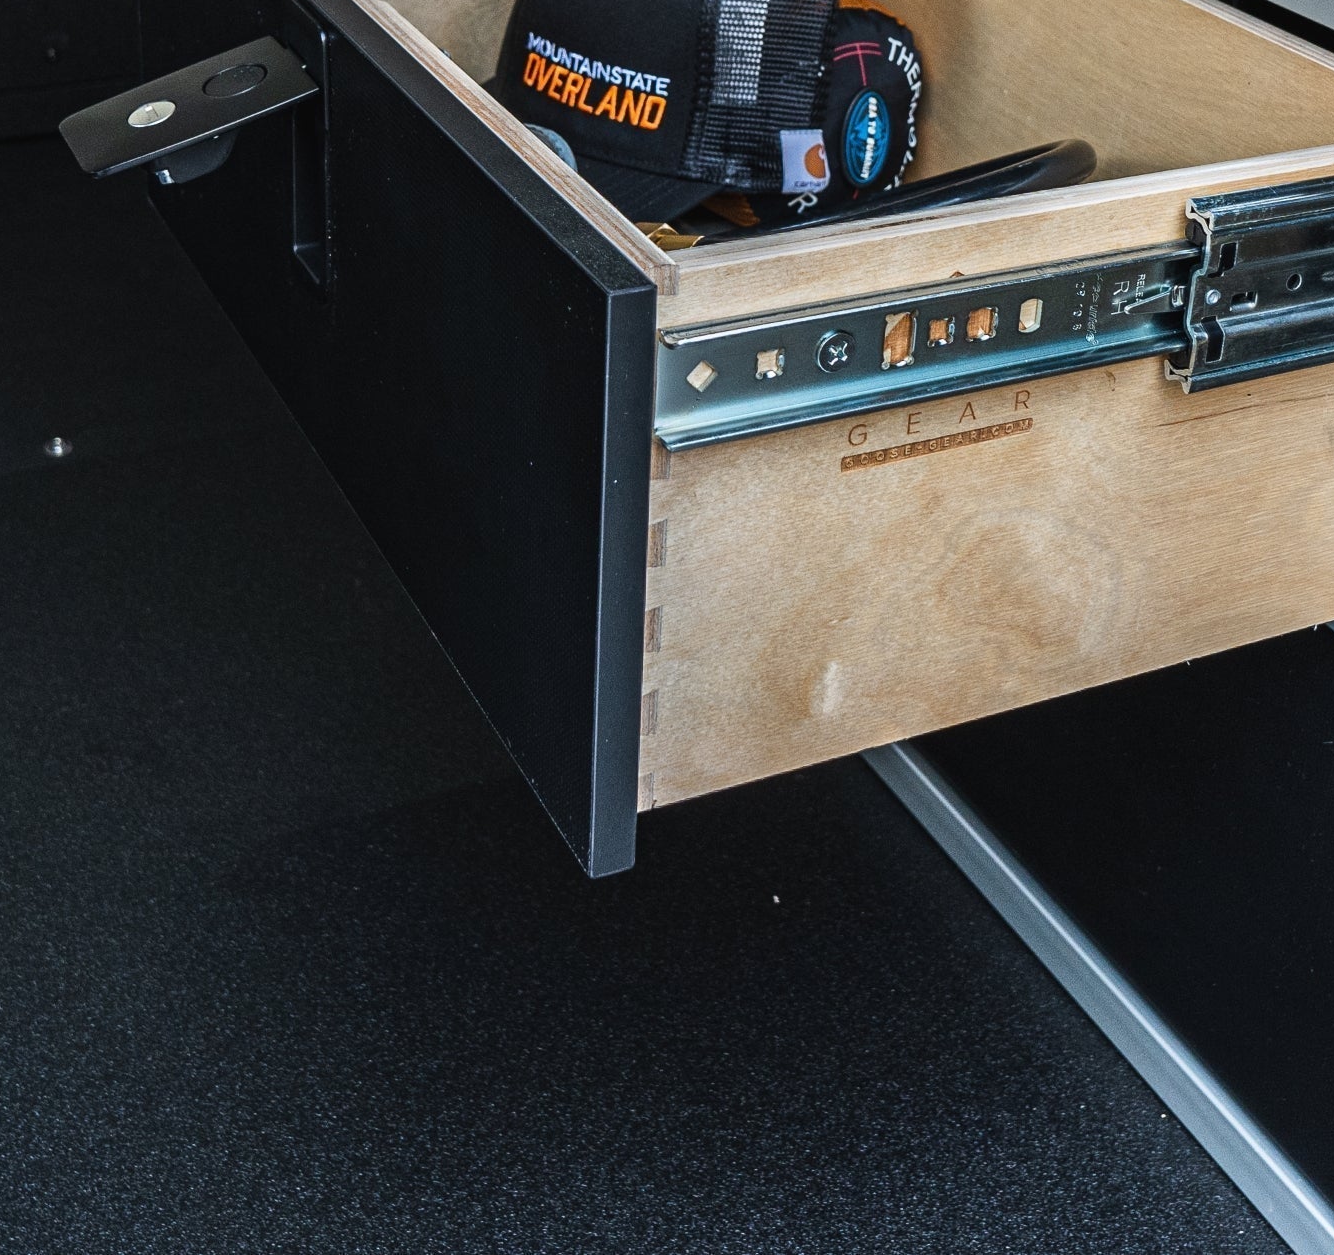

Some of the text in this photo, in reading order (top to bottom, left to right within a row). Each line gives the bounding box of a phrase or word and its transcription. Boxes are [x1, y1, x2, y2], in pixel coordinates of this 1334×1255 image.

[523, 52, 666, 130] OVERLAND
[526, 32, 671, 96] MOUNTAINSTATE
[848, 389, 1030, 446] GEAR
